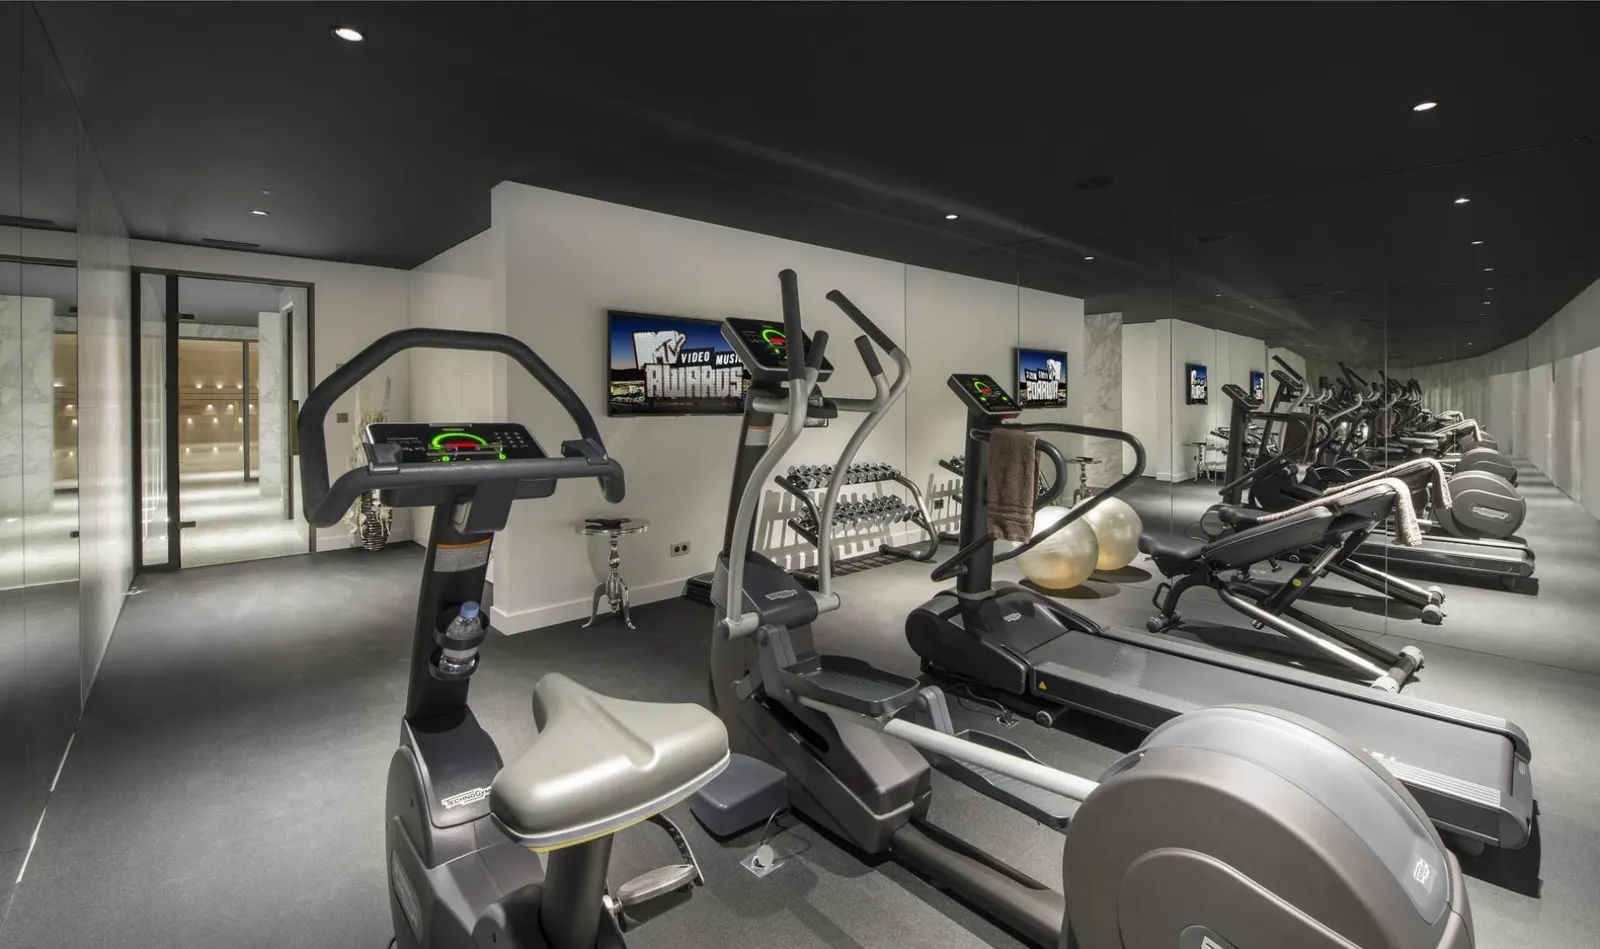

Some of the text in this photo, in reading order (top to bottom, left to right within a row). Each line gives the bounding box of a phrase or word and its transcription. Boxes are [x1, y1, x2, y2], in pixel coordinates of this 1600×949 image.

[633, 330, 687, 371] MTV
[681, 351, 710, 364] VIDEO
[645, 364, 743, 398] AWARDS
